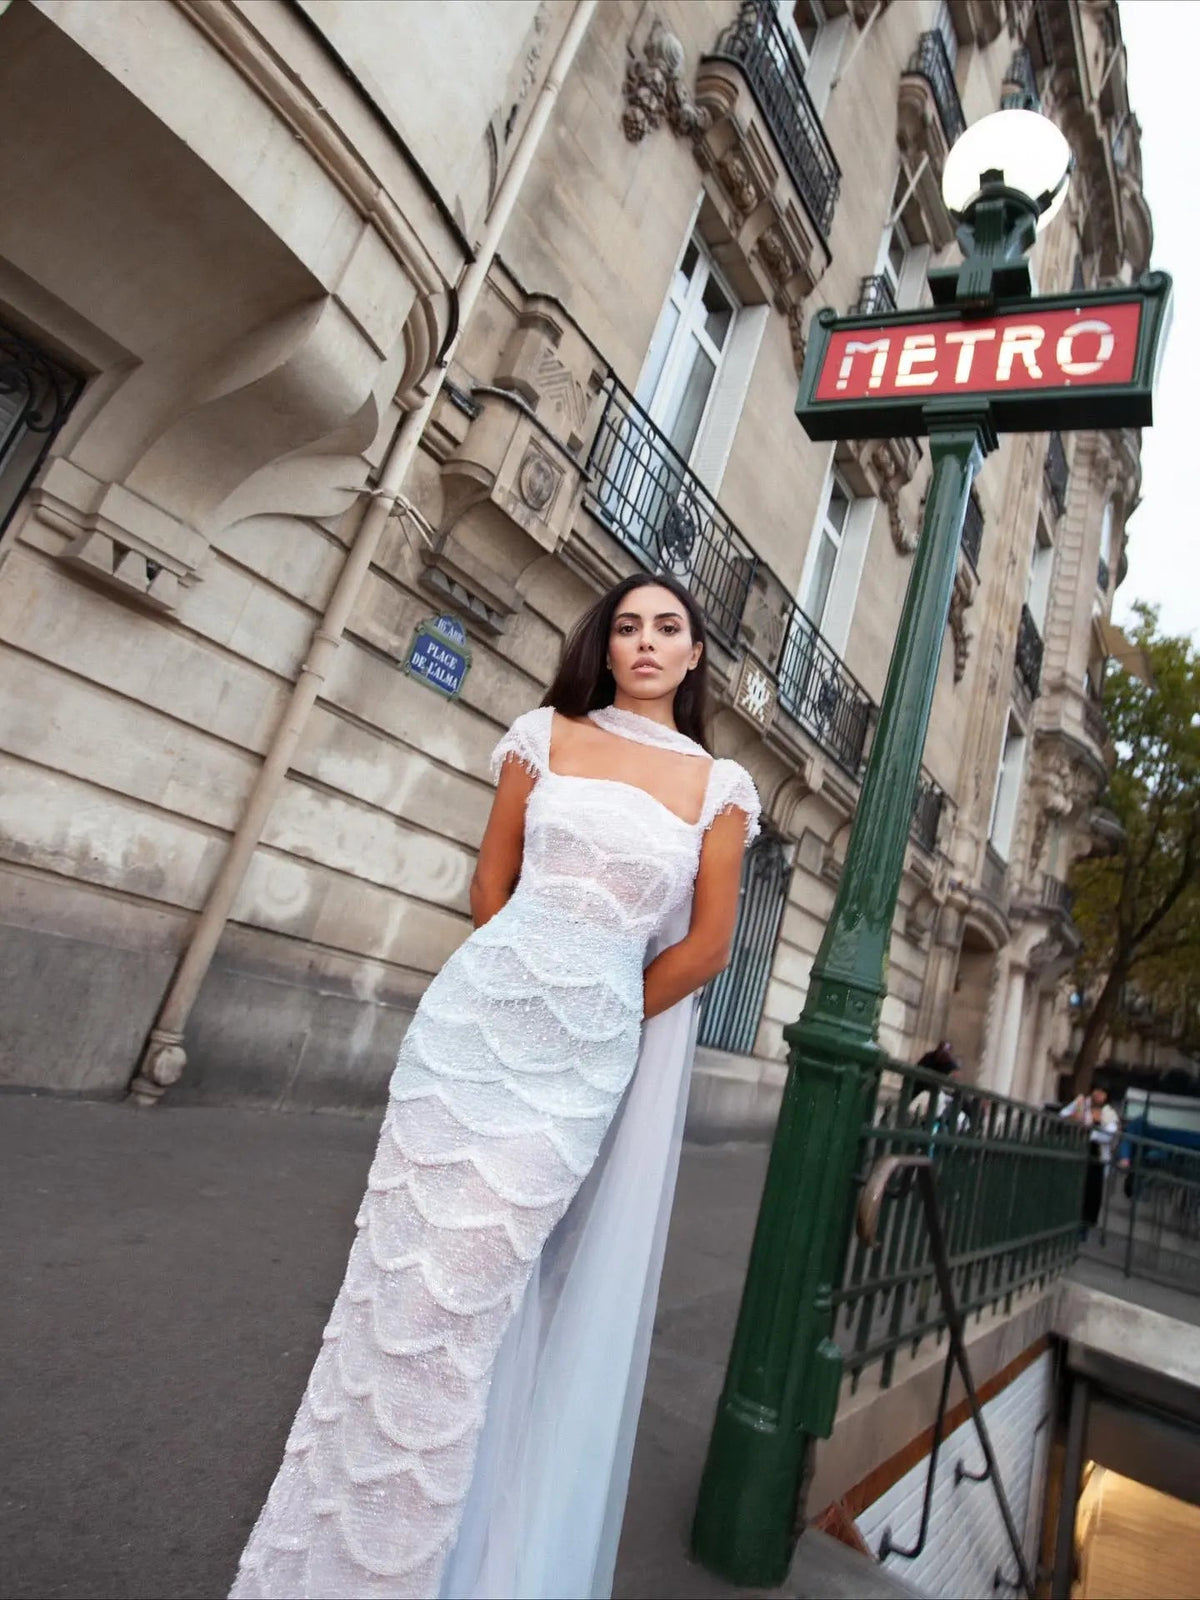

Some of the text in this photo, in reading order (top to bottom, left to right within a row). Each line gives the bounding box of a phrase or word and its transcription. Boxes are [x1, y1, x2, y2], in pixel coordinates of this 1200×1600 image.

[836, 320, 1114, 390] METRO
[411, 653, 459, 689] DE L'ALMA
[426, 642, 458, 670] PLACE
